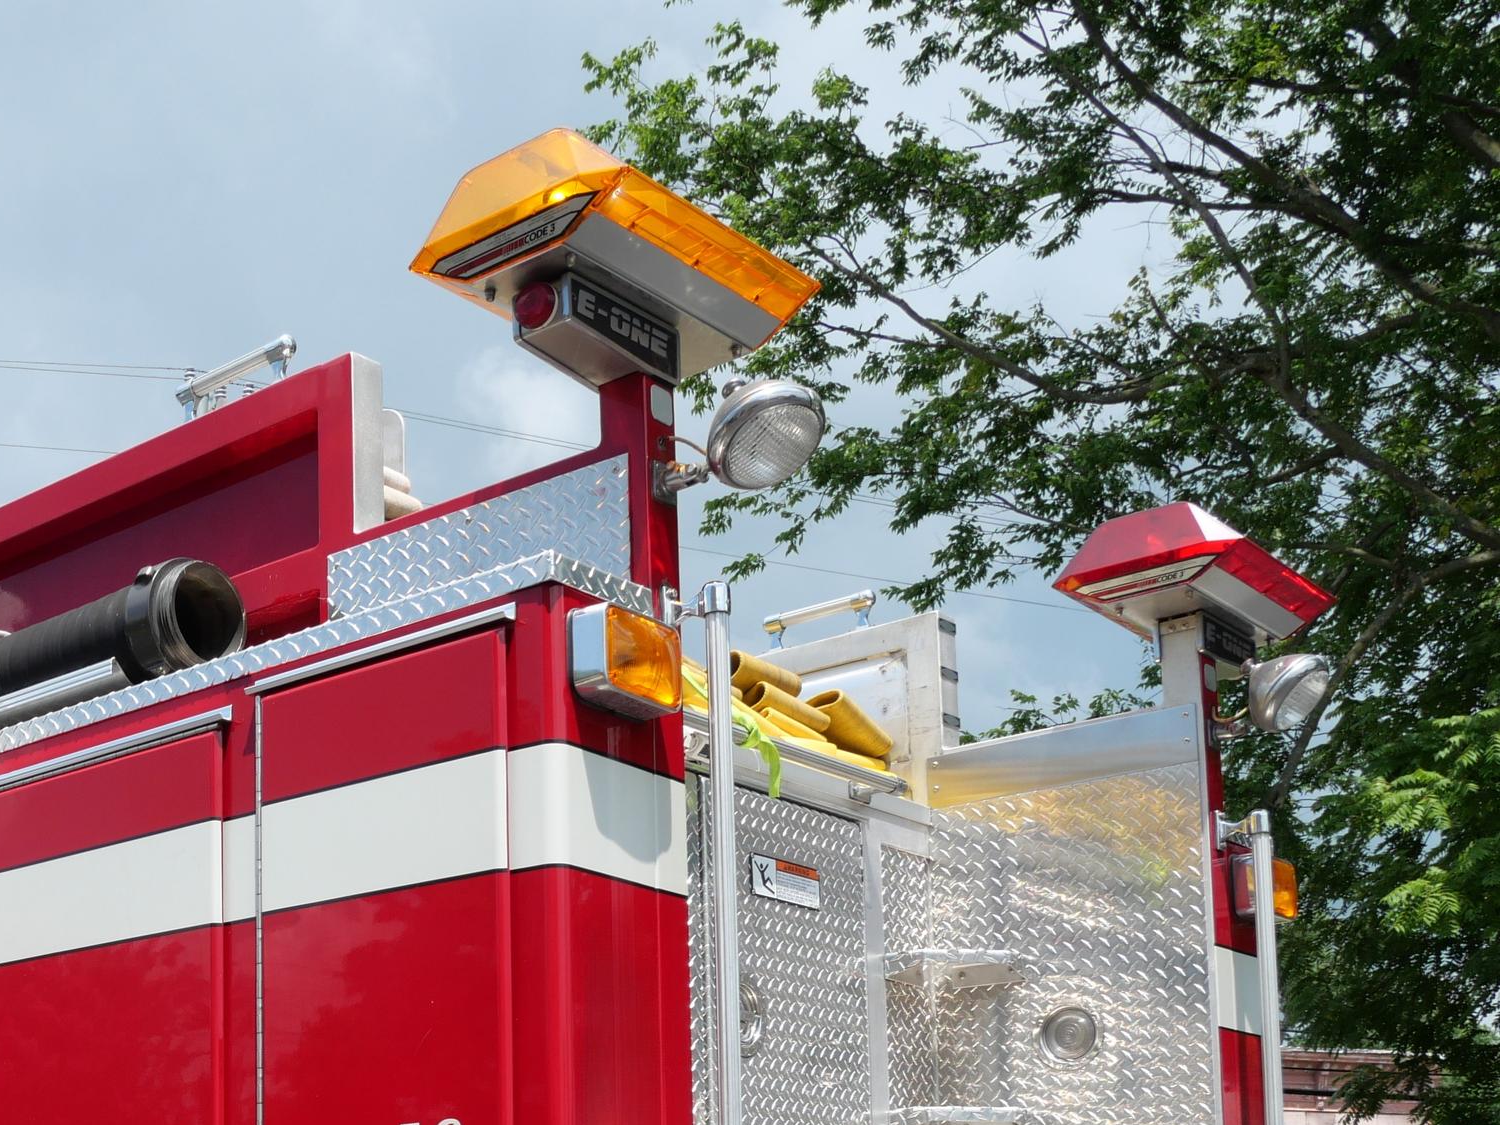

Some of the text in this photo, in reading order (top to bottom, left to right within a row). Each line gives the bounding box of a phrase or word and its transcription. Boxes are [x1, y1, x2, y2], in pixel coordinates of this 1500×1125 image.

[523, 226, 549, 244] CODE
[549, 223, 556, 233] 3
[577, 288, 669, 358] E-ONE
[1156, 573, 1178, 583] CODE
